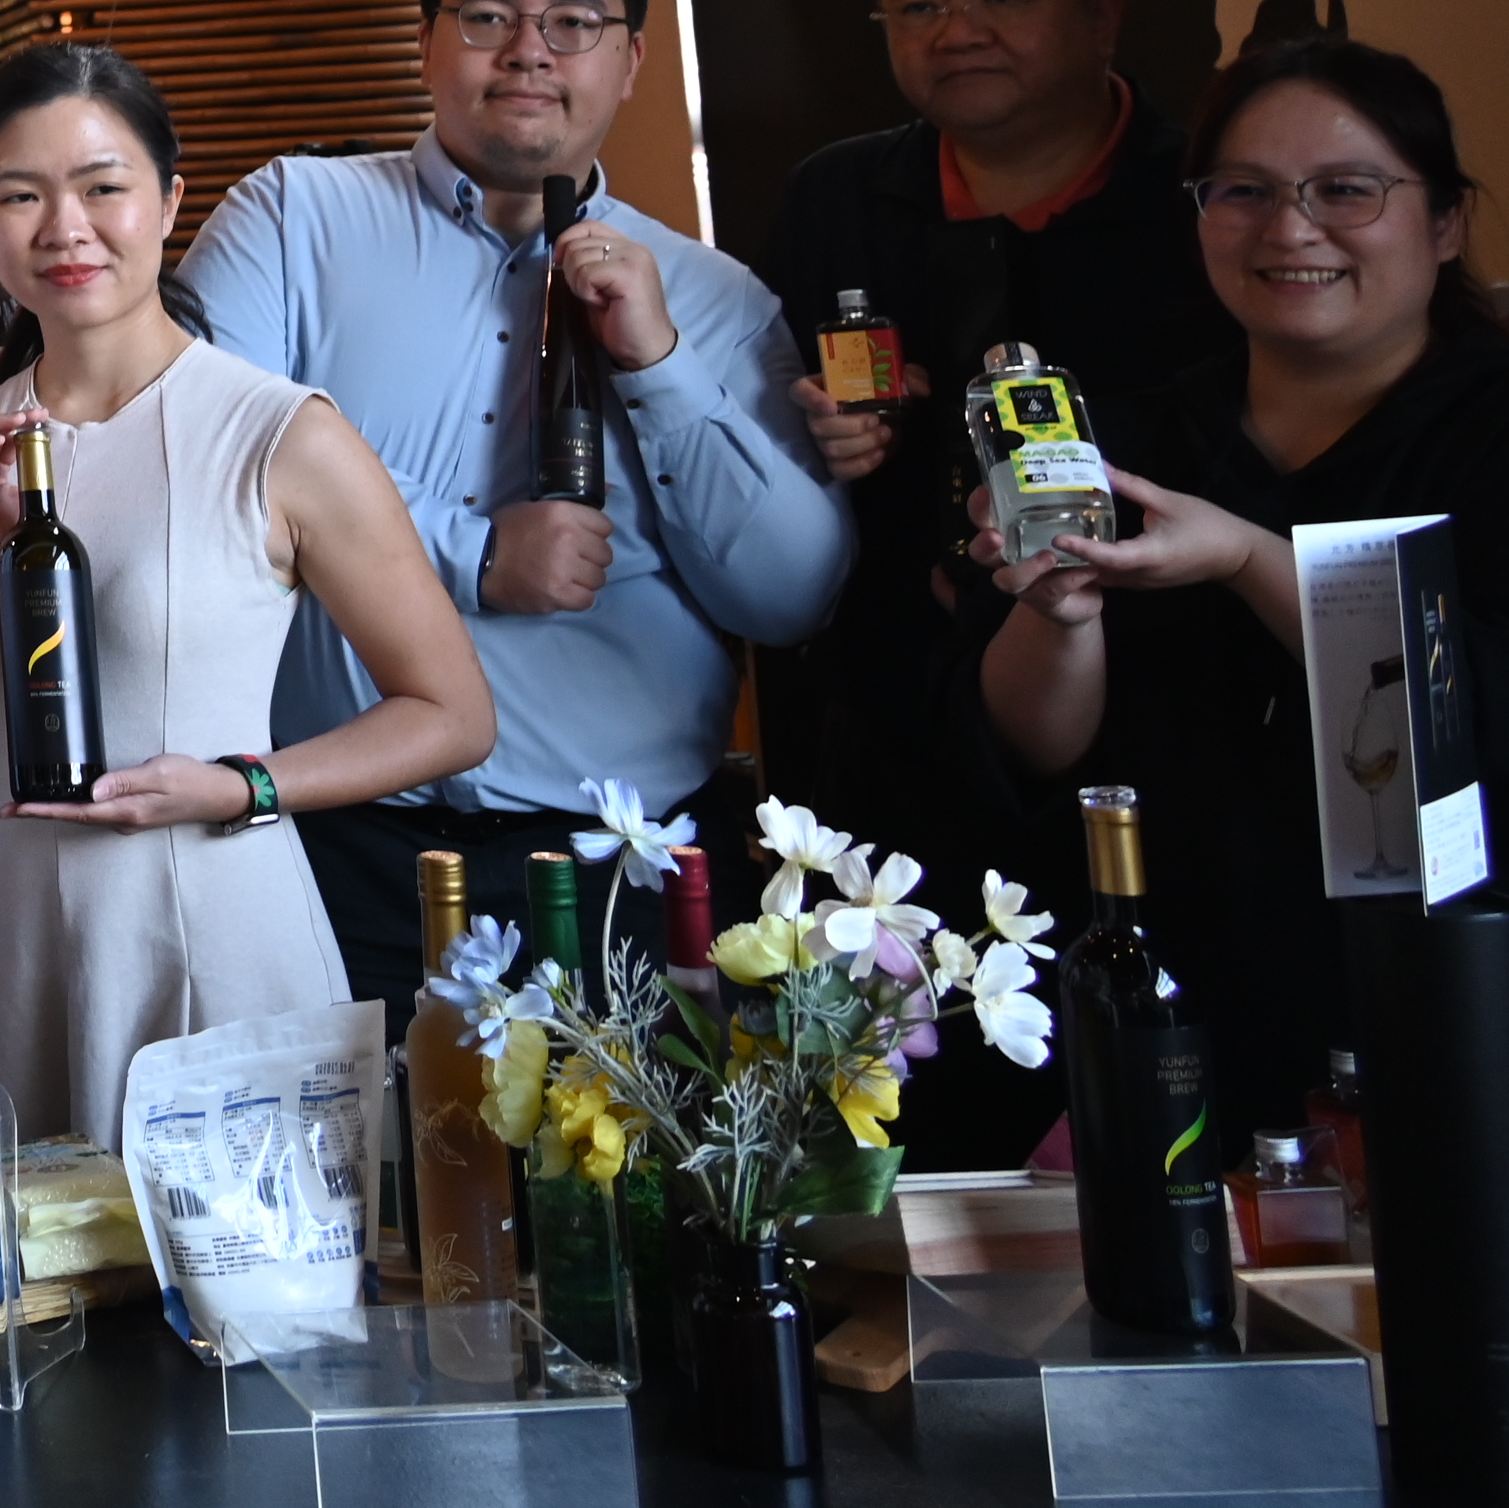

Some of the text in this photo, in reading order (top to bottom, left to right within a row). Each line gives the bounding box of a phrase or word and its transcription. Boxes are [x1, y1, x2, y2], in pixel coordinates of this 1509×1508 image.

[32, 608, 56, 616] BREW
[1169, 1082, 1198, 1096] BREW
[1204, 1180, 1217, 1192] TEA
